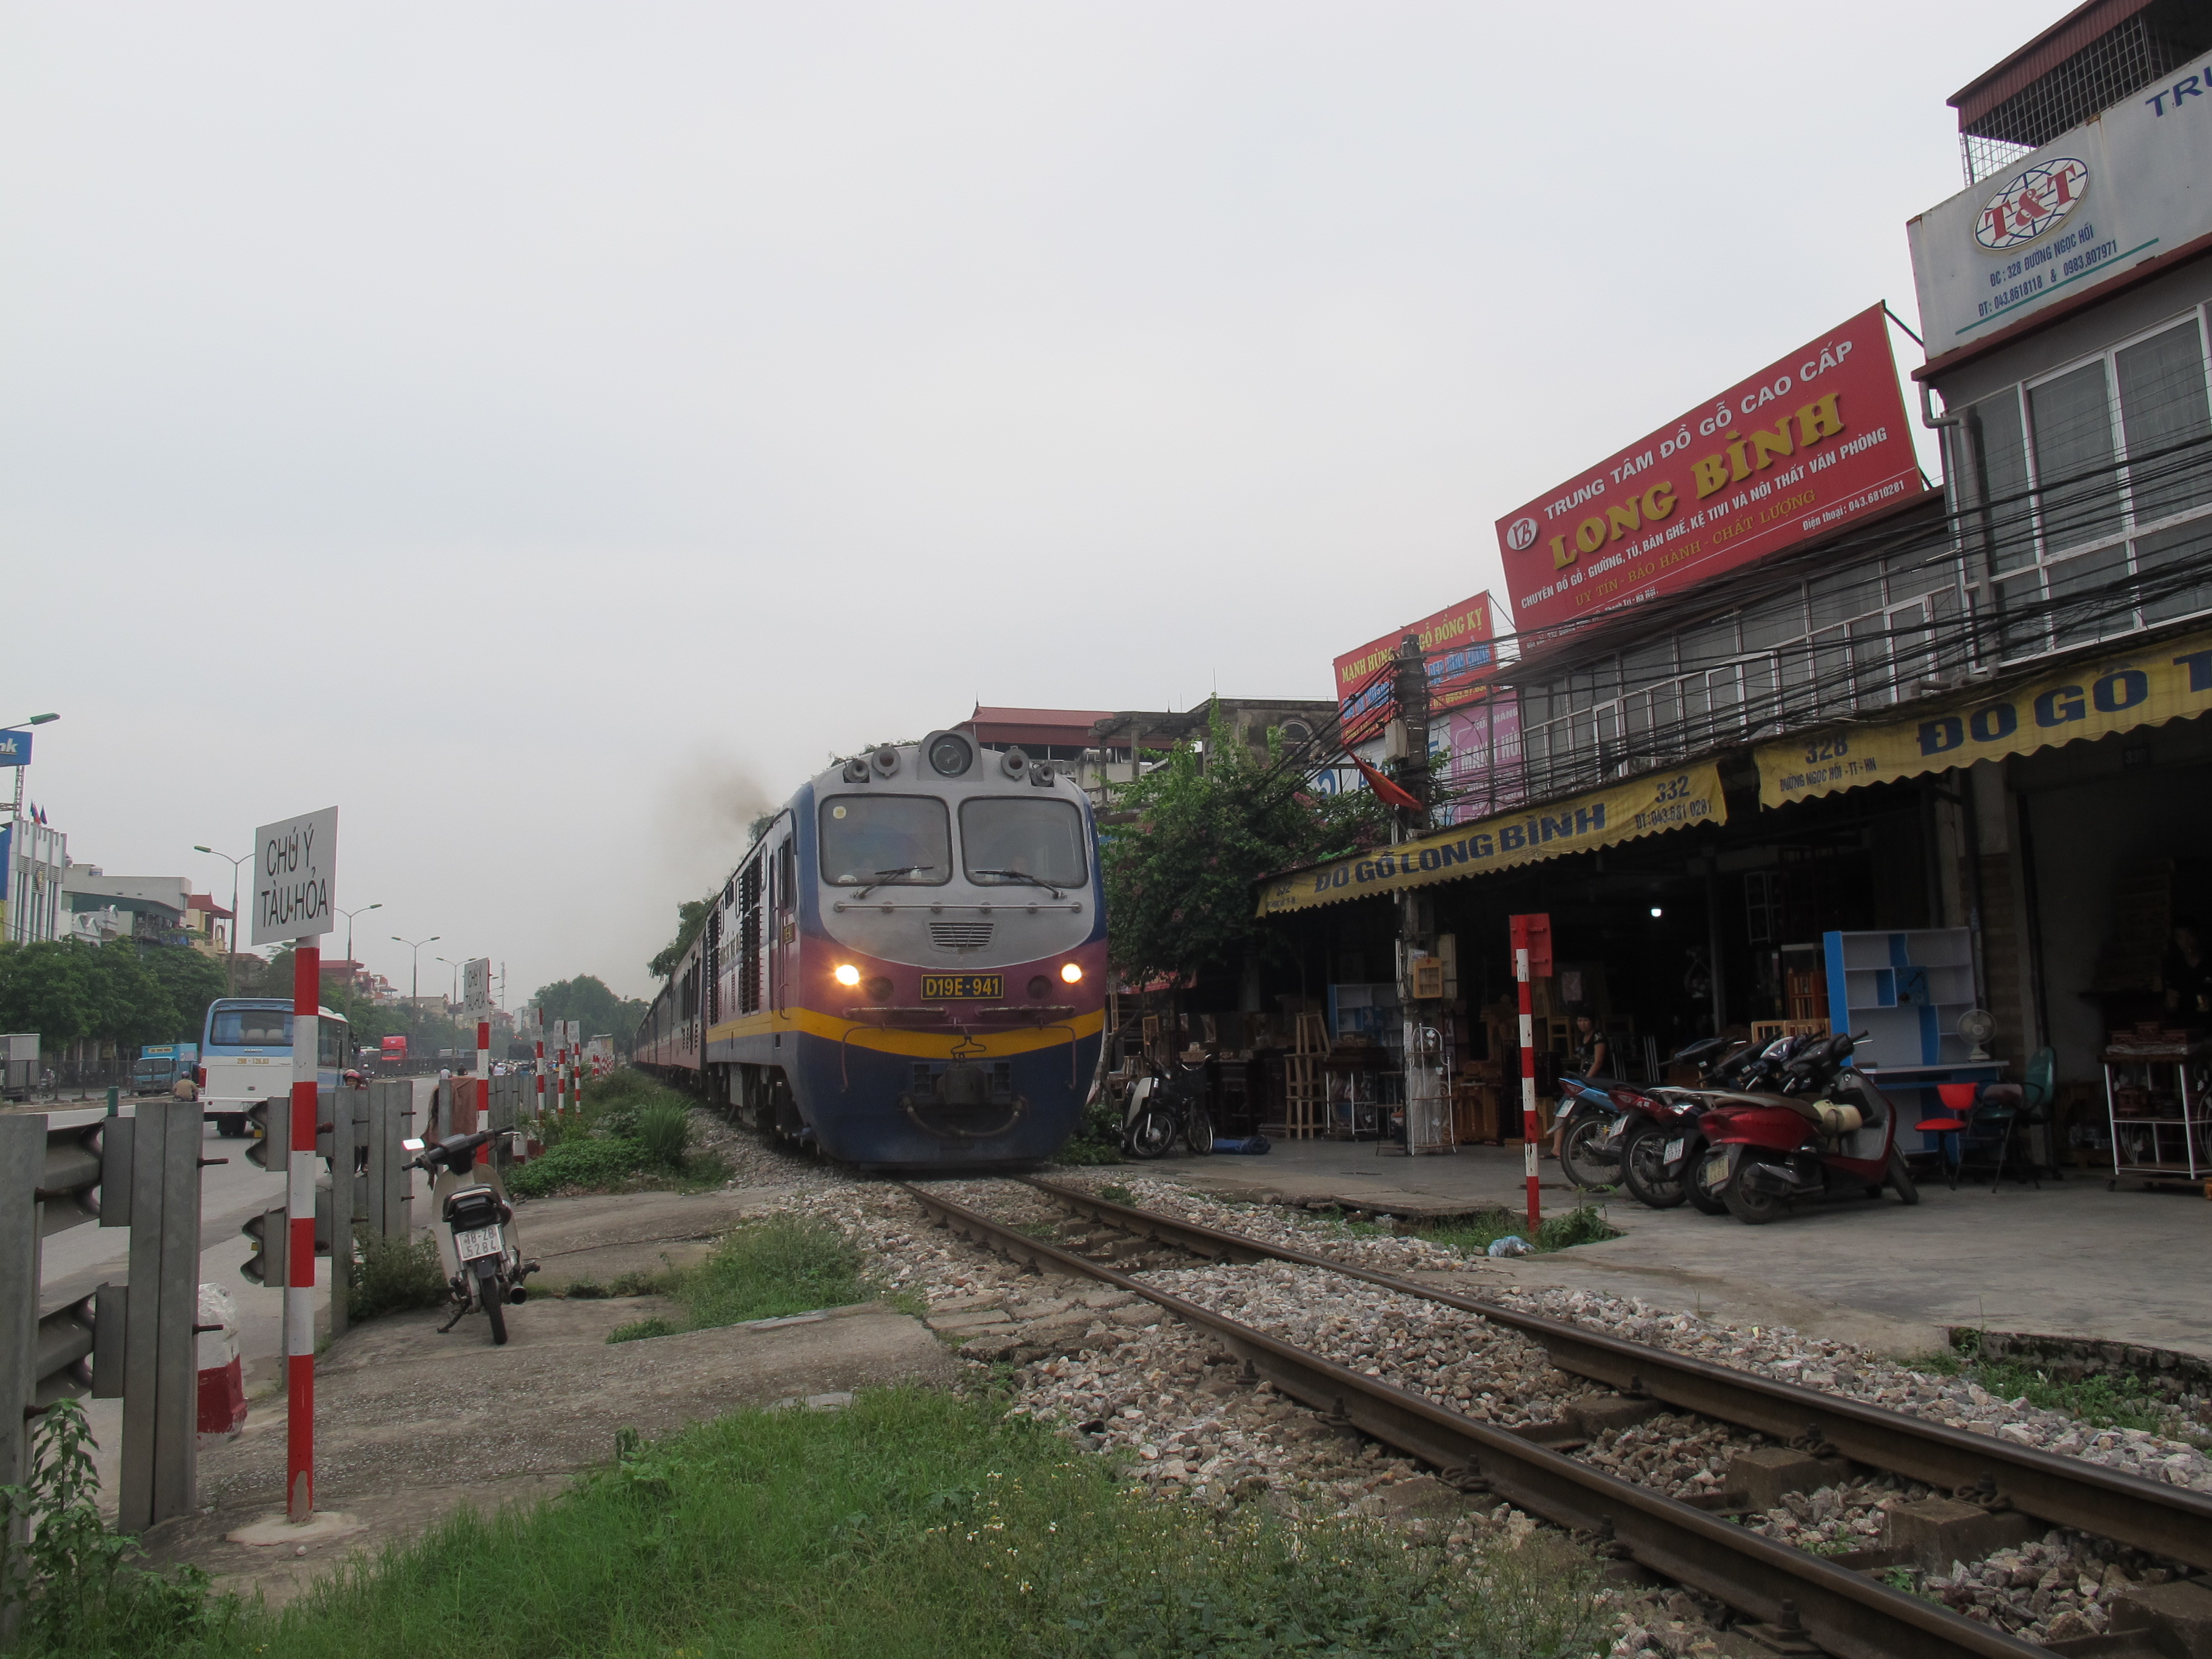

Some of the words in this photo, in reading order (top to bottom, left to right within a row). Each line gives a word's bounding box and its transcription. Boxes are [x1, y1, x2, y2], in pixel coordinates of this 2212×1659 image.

[1984, 164, 2077, 242] T&T
[2007, 261, 2022, 279] 328
[2053, 234, 2076, 258] NGỌC
[1994, 275, 2043, 309] 043.8618118
[2050, 269, 2057, 283] &
[1544, 478, 1606, 520] TRUNG
[1610, 451, 1654, 484] TÂM
[1660, 423, 1692, 459] ĐỒ
[1699, 400, 1732, 437] GỖ
[1741, 376, 1792, 414] CAO
[1800, 340, 1852, 382] CẤP
[1549, 481, 1678, 569] LONG
[1690, 393, 1845, 500] BÌNH
[1803, 516, 1821, 531] Điện
[1848, 480, 1905, 512] 043.6810281
[1521, 585, 1555, 609] CHUYÊN
[1642, 532, 1664, 552] BÀN
[1690, 511, 1706, 529] KỆ
[1708, 501, 1729, 521] TIVI
[1732, 491, 1749, 509] VÀ
[1750, 481, 1772, 501] NỘI
[1774, 463, 1805, 491] THẤT
[1809, 451, 1836, 474] VĂN
[1839, 427, 1888, 460] PHÒNG
[1575, 590, 1592, 606] UY
[1596, 578, 1618, 597] TÍN
[1627, 561, 1655, 583] BẢO
[1659, 541, 1702, 569] HÀNH
[1712, 514, 1755, 545] CHẤT
[1760, 489, 1817, 524] LƯỢNG
[1341, 657, 1366, 683] MẠNH
[1434, 614, 1464, 644] ĐỒNG
[1805, 733, 1848, 764] 328
[1863, 757, 1877, 772] HN
[1655, 775, 1691, 803] 332
[267, 826, 298, 877] CHÚ
[304, 822, 314, 868] Ý
[1401, 833, 1495, 874] LONG
[261, 880, 290, 928] TÀU
[295, 866, 328, 921] HỎA
